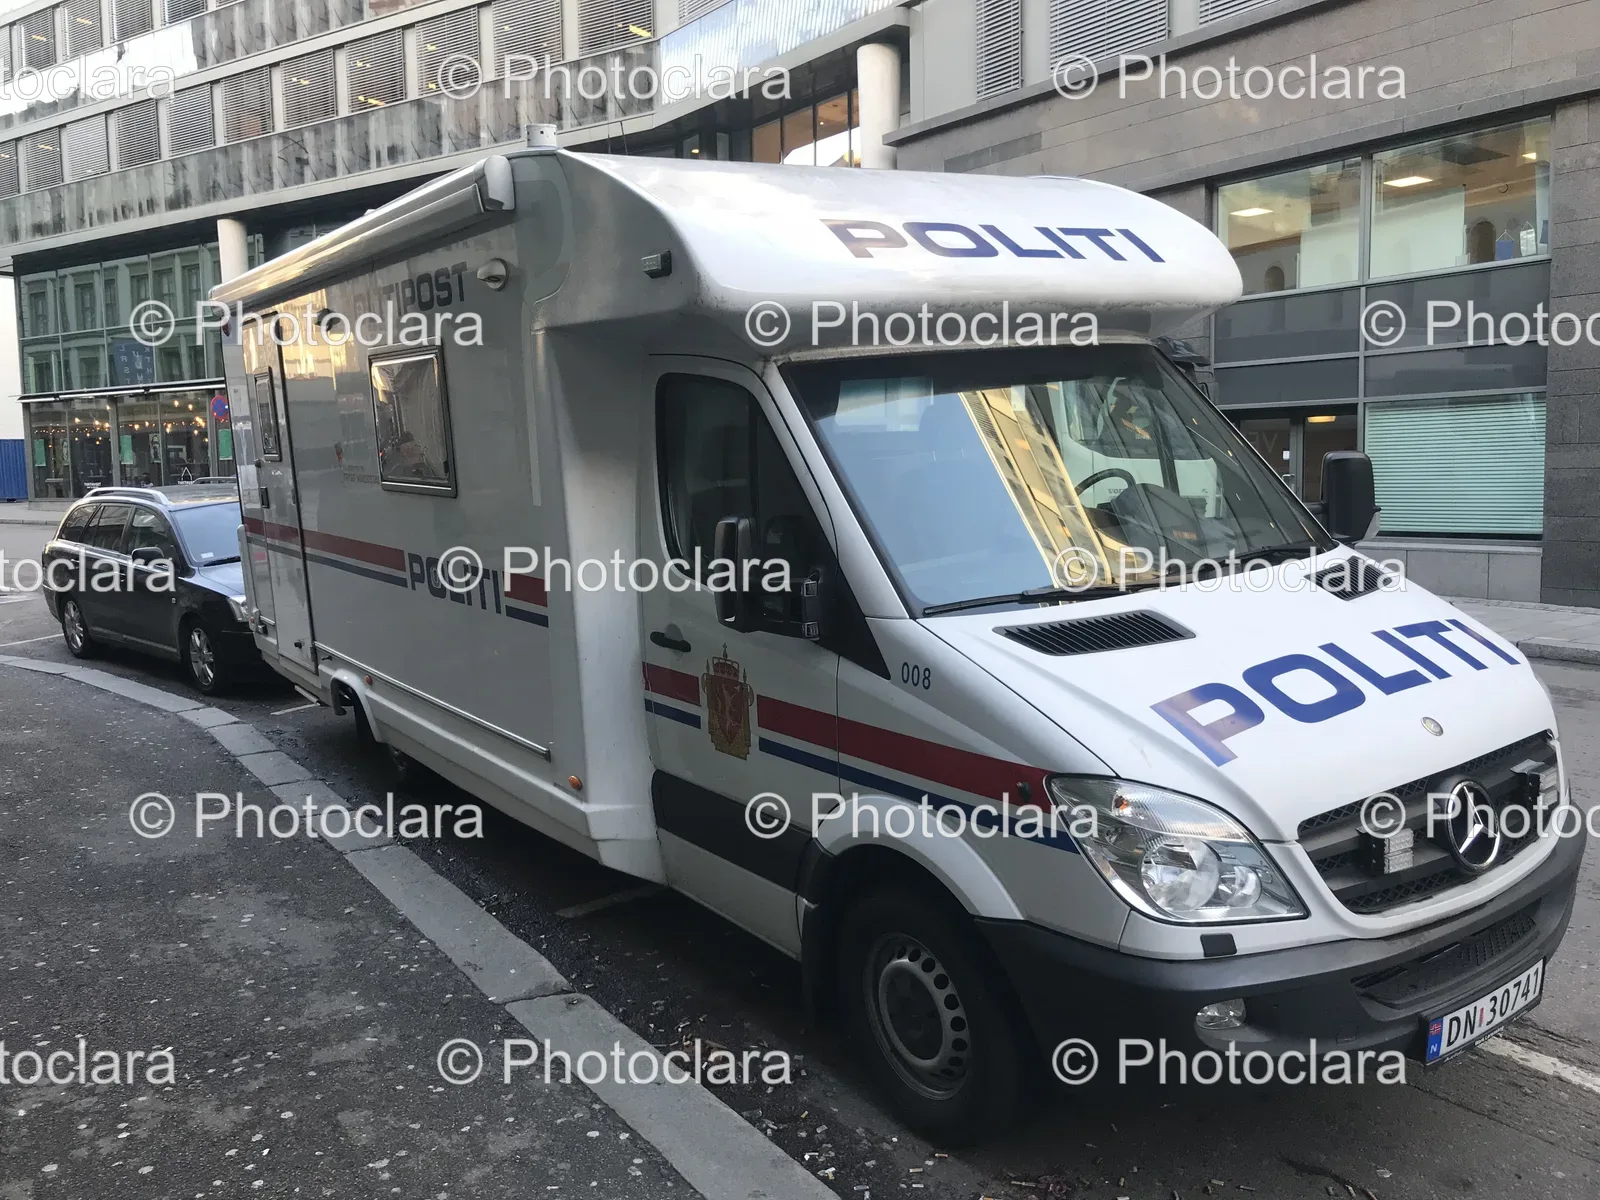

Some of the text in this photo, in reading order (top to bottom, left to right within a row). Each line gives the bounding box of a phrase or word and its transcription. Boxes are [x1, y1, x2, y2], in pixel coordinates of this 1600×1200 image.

[819, 219, 1166, 263] POLITI
[408, 552, 502, 614] POLITI
[901, 661, 931, 690] 008
[1149, 618, 1521, 767] POLITI
[1446, 1005, 1478, 1047] DN
[1485, 967, 1539, 1026] 30741
[1430, 1043, 1438, 1053] N
